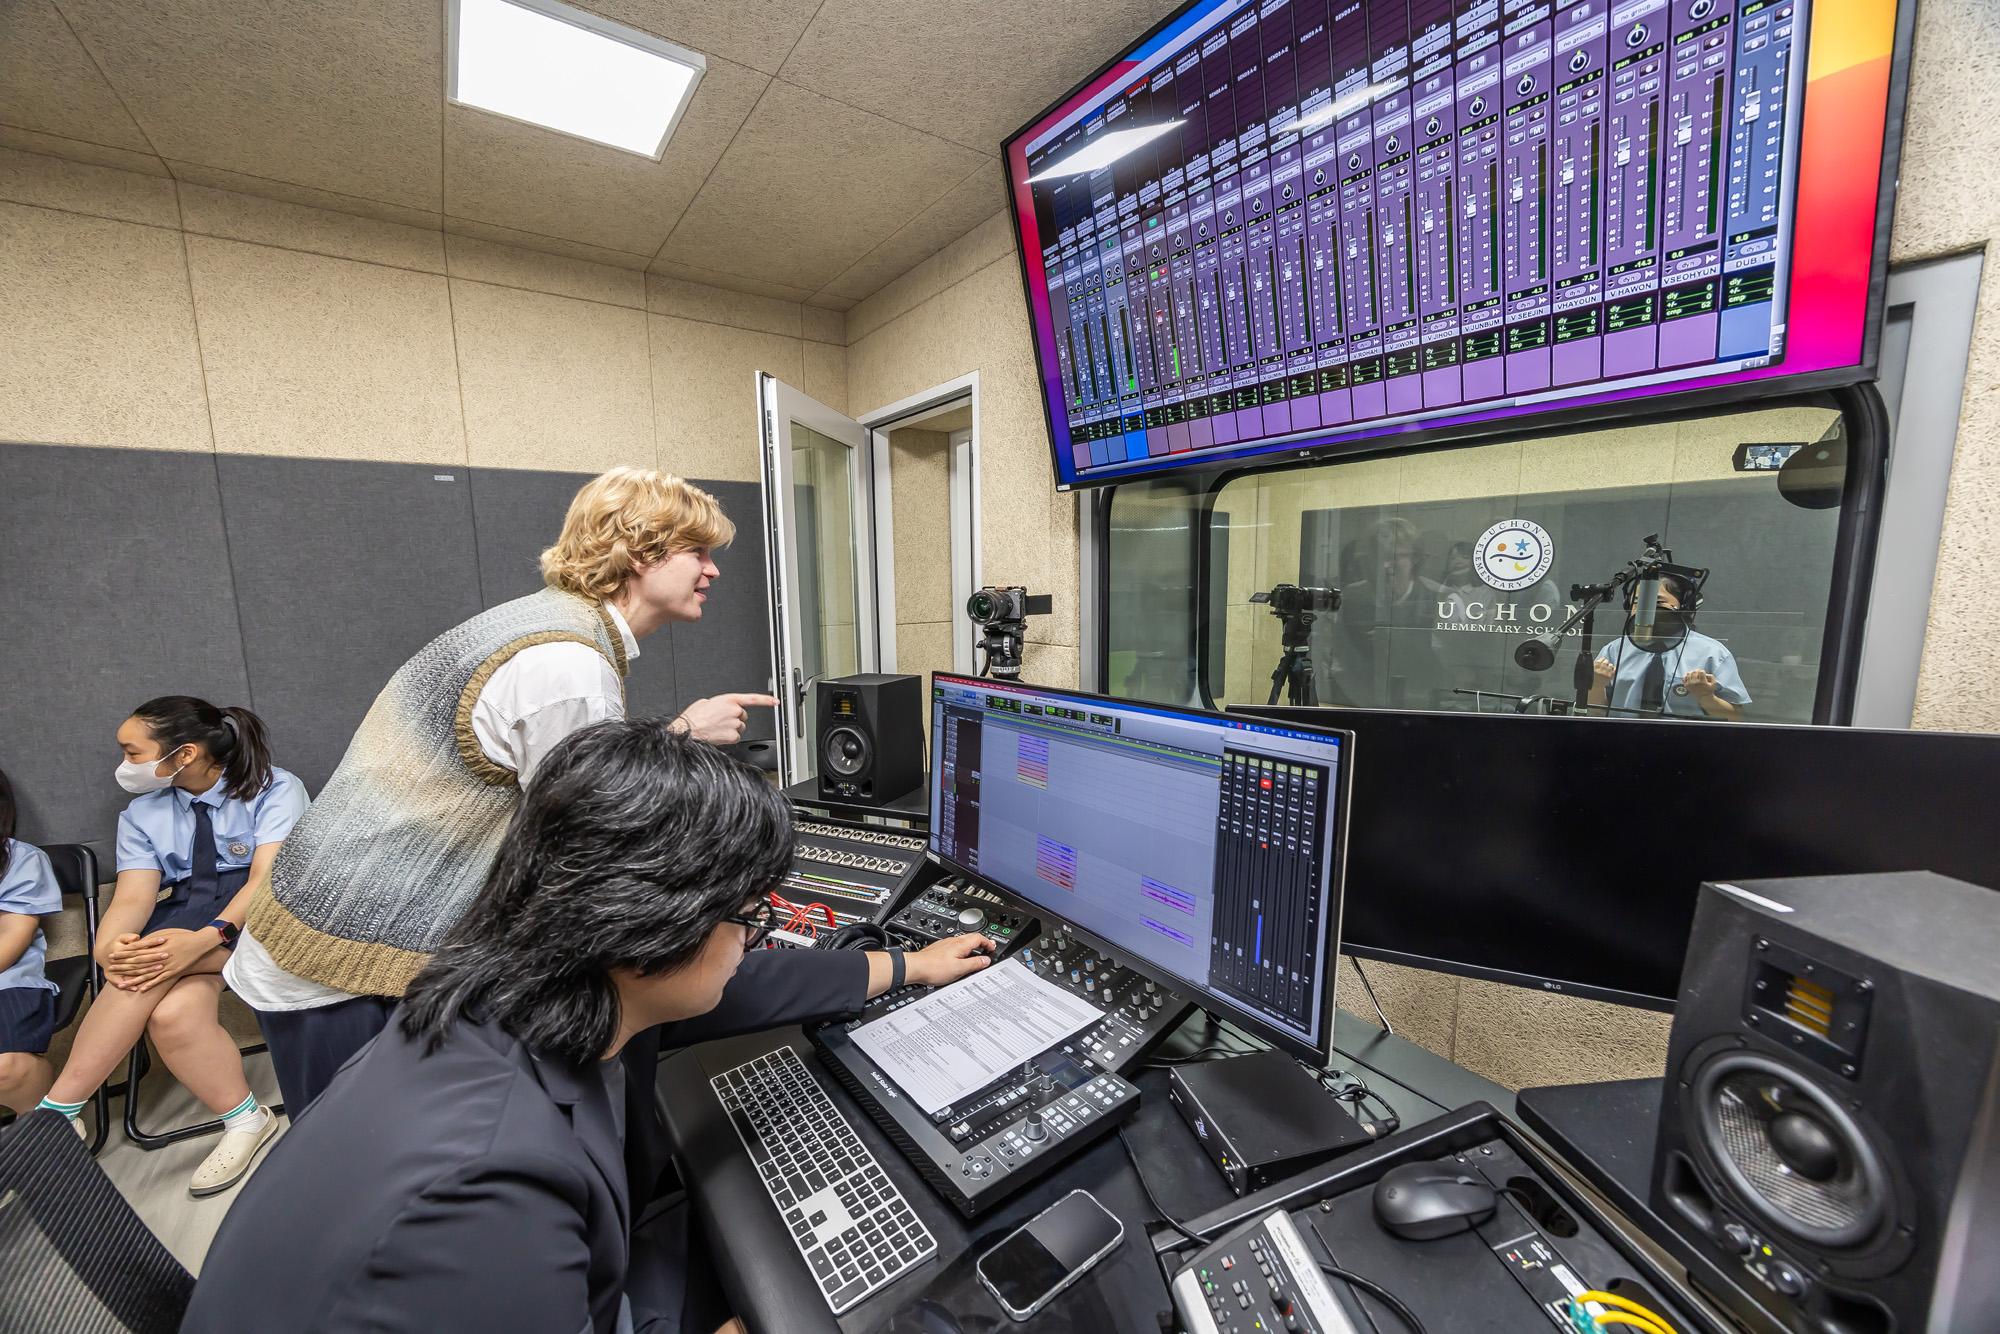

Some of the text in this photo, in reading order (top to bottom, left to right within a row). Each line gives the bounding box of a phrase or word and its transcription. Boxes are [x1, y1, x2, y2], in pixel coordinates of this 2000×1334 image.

[1518, 4, 1535, 18] AUTO
[1631, 4, 1651, 18] group
[1745, 2, 1764, 15] pan
[1468, 30, 1486, 43] AUTO
[1574, 31, 1592, 44] group
[1677, 32, 1694, 44] pan
[1424, 54, 1439, 65] AUTO
[1521, 56, 1537, 68] group
[1615, 59, 1630, 70] pan
[1708, 56, 1719, 64] M
[1383, 76, 1397, 86] AUTO
[1472, 80, 1488, 92] group
[1560, 83, 1573, 94] pan
[1644, 82, 1654, 91] M
[1508, 106, 1521, 116] pan
[1462, 126, 1473, 136] pan
[1418, 145, 1430, 154] pan
[1735, 234, 1749, 243] 0.0
[1746, 245, 1761, 254] dyn
[1672, 250, 1684, 260] 0.0
[1736, 258, 1758, 268] DUB
[1613, 265, 1625, 274] 0.0
[1664, 267, 1717, 284] VSEOHYUN
[1560, 280, 1571, 288] 0.0
[1728, 278, 1744, 286] dly
[1618, 282, 1652, 296] HAWON
[1666, 283, 1713, 301] dly 0
[1512, 292, 1522, 300] 0.0
[1728, 294, 1747, 303] cmp
[1518, 308, 1544, 320] SEEJIN
[1610, 305, 1622, 314] dly
[1666, 308, 1683, 316] cmp
[1470, 318, 1500, 331] JUNBUM
[1558, 317, 1568, 325] dly
[1609, 320, 1625, 329] cmp
[1433, 330, 1453, 340] JIHOO
[1510, 328, 1520, 336] dly
[1557, 332, 1572, 340] cmp
[1395, 340, 1414, 349] JIWON
[1510, 342, 1523, 350] cmp
[1489, 520, 1542, 536] UCHON
[1476, 543, 1523, 589] ELEMENTARY
[1528, 541, 1551, 583] SCHOOL
[1437, 622, 1583, 636] ELEMENTARY SCHOL
[870, 1072, 898, 1098] Solid State Logic
